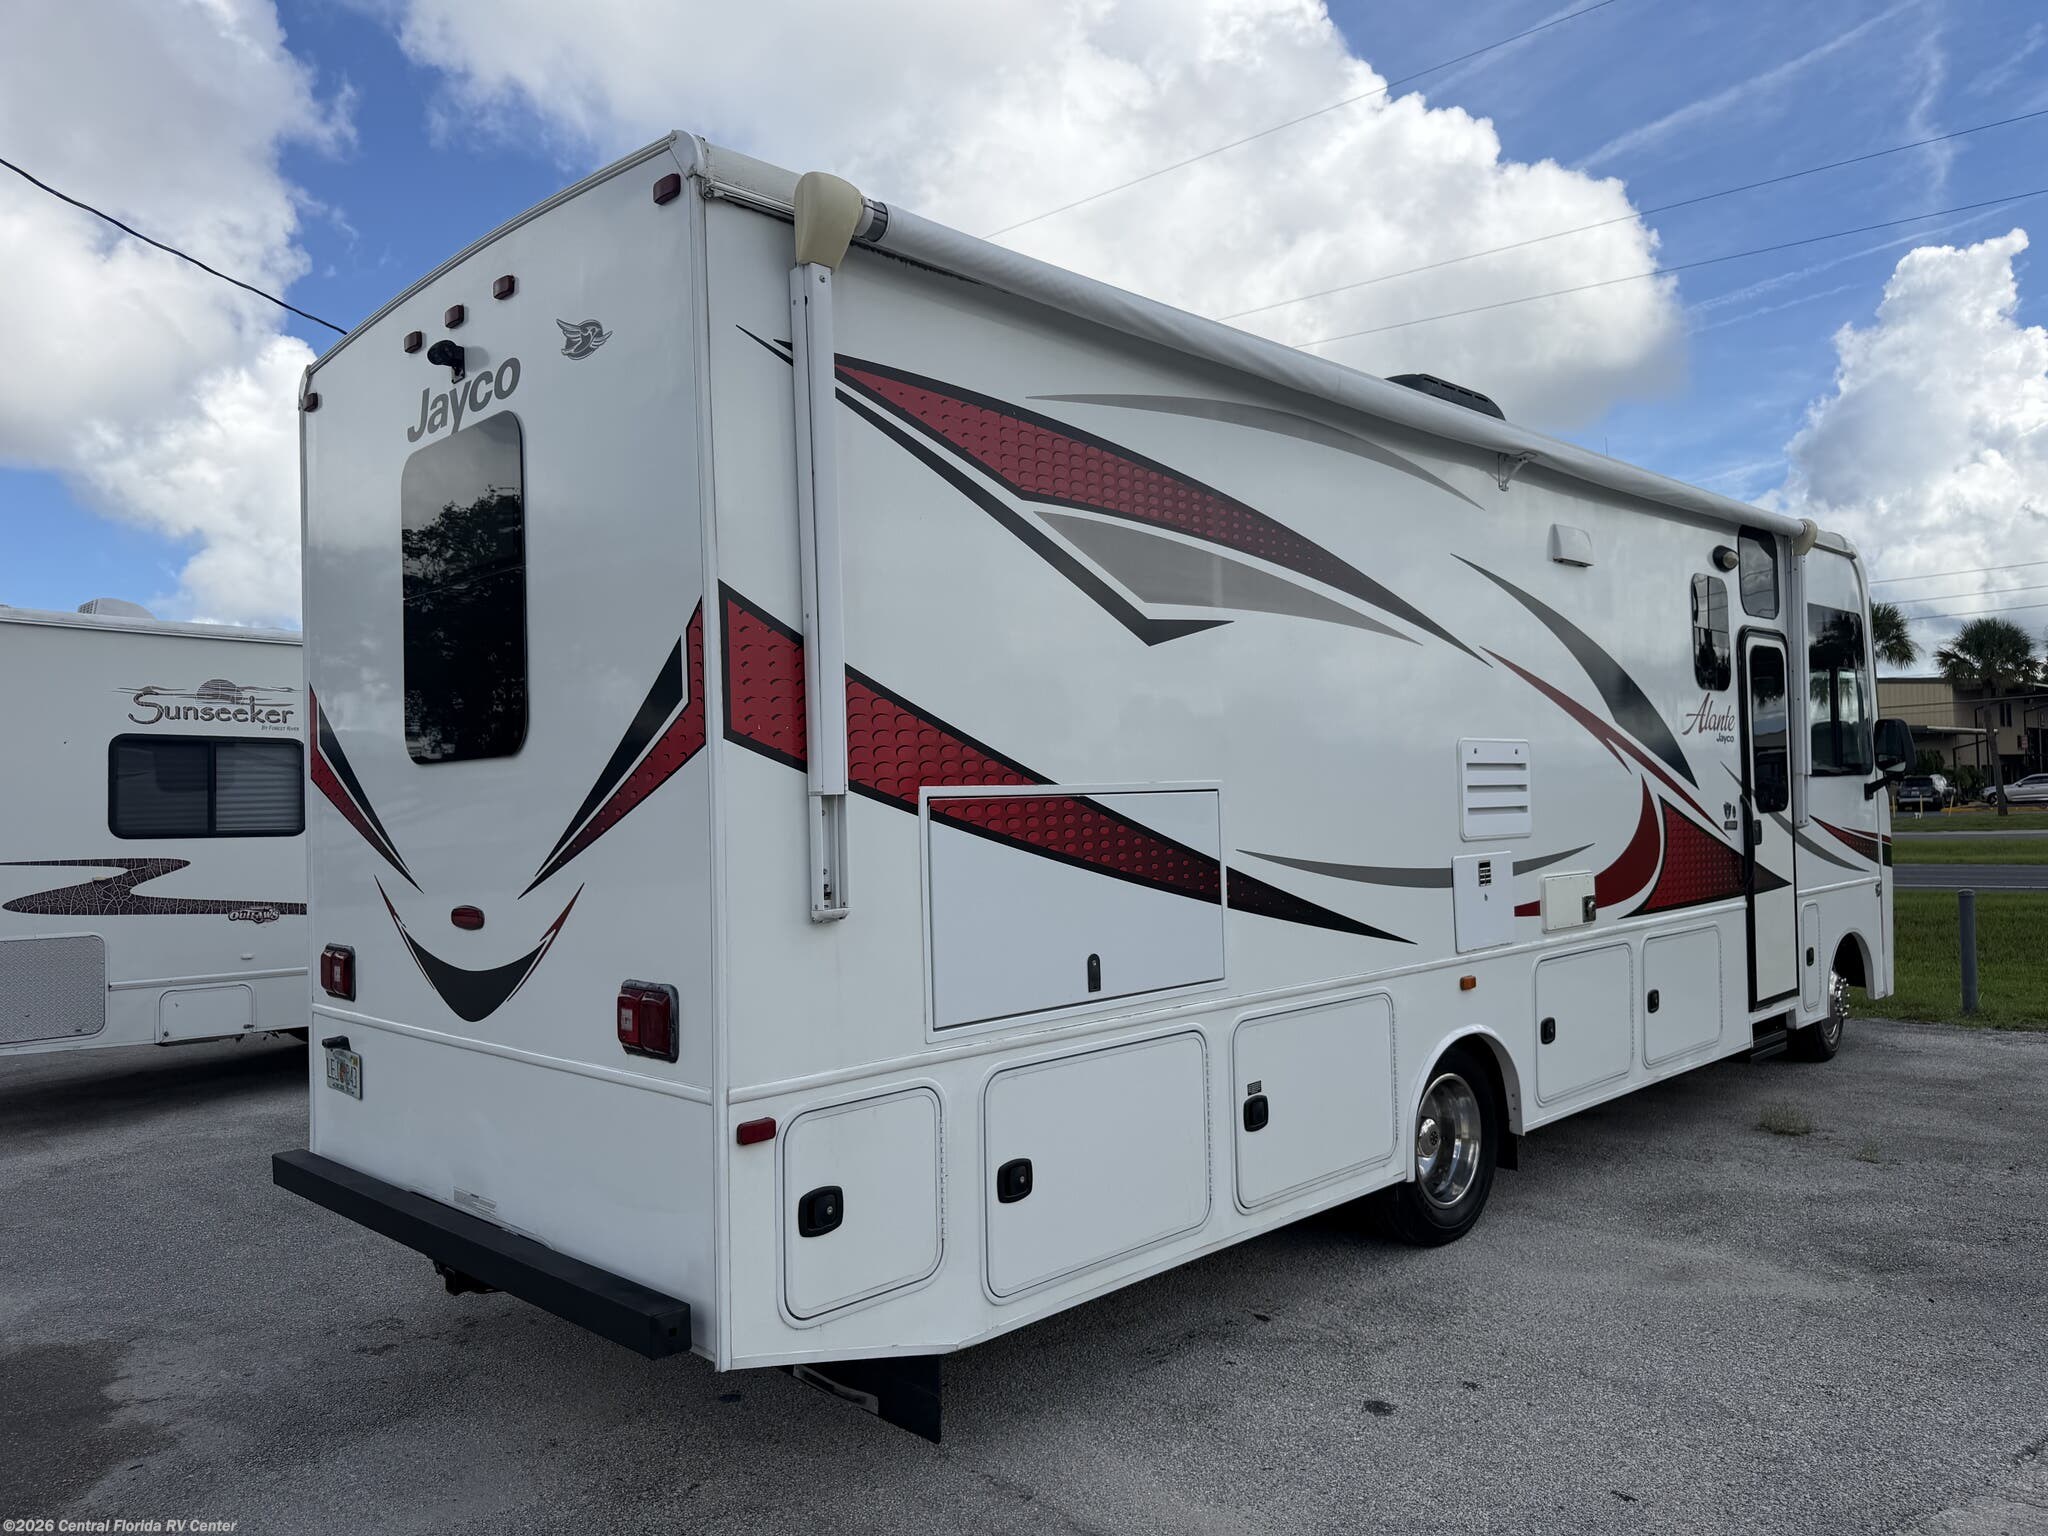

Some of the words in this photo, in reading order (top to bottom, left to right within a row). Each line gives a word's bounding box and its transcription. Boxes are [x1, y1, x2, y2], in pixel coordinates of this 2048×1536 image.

[407, 357, 521, 443] Jayco
[128, 692, 294, 724] Sunseeker
[1681, 692, 1735, 735] Alante
[1716, 732, 1735, 744] Jayco
